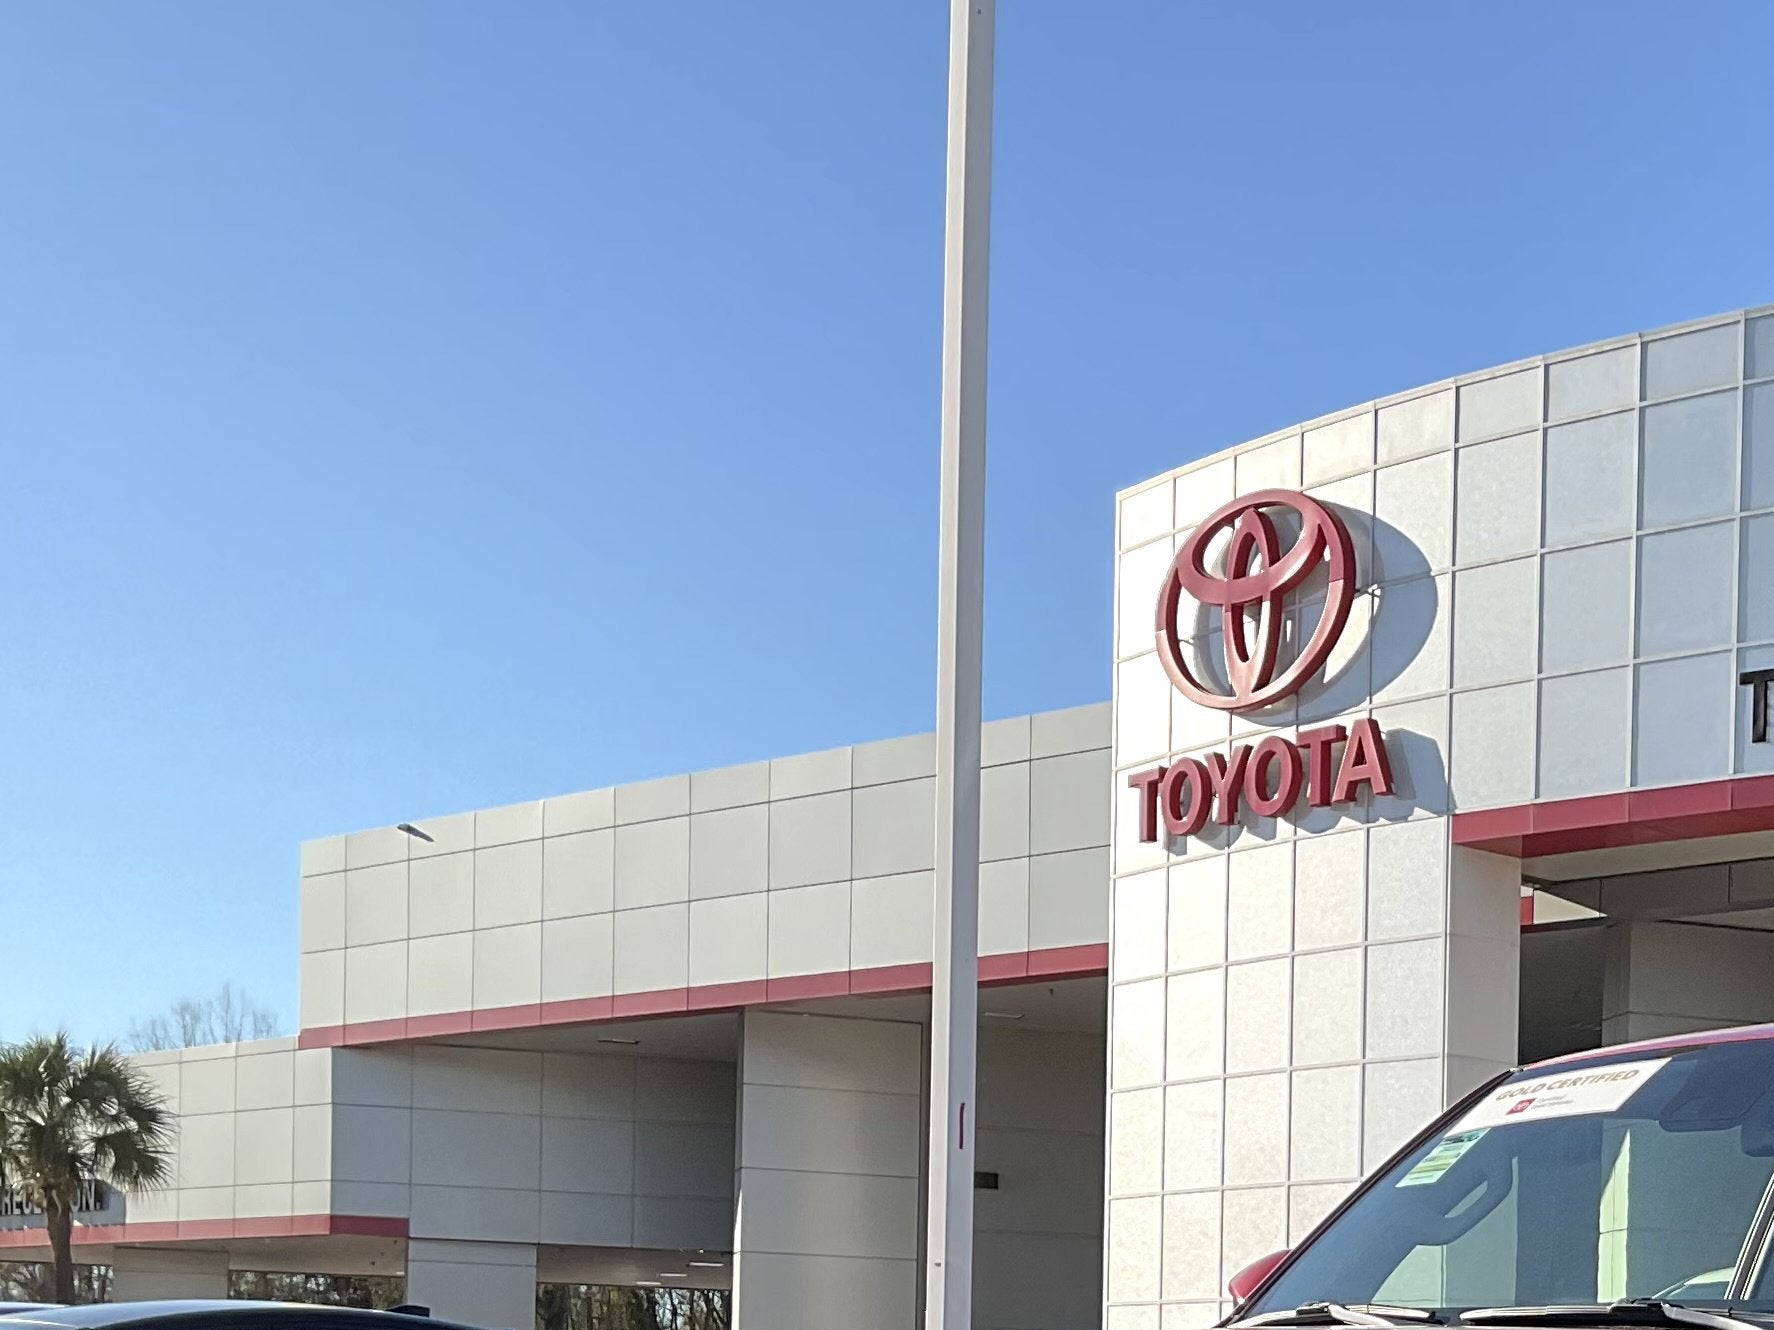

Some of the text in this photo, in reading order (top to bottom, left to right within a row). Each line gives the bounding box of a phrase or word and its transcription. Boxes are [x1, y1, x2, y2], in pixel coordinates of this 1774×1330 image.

[1128, 718, 1395, 843] TOYOTA
[1496, 1083, 1547, 1101] GOLD
[1547, 1069, 1639, 1090] CERTIFIED
